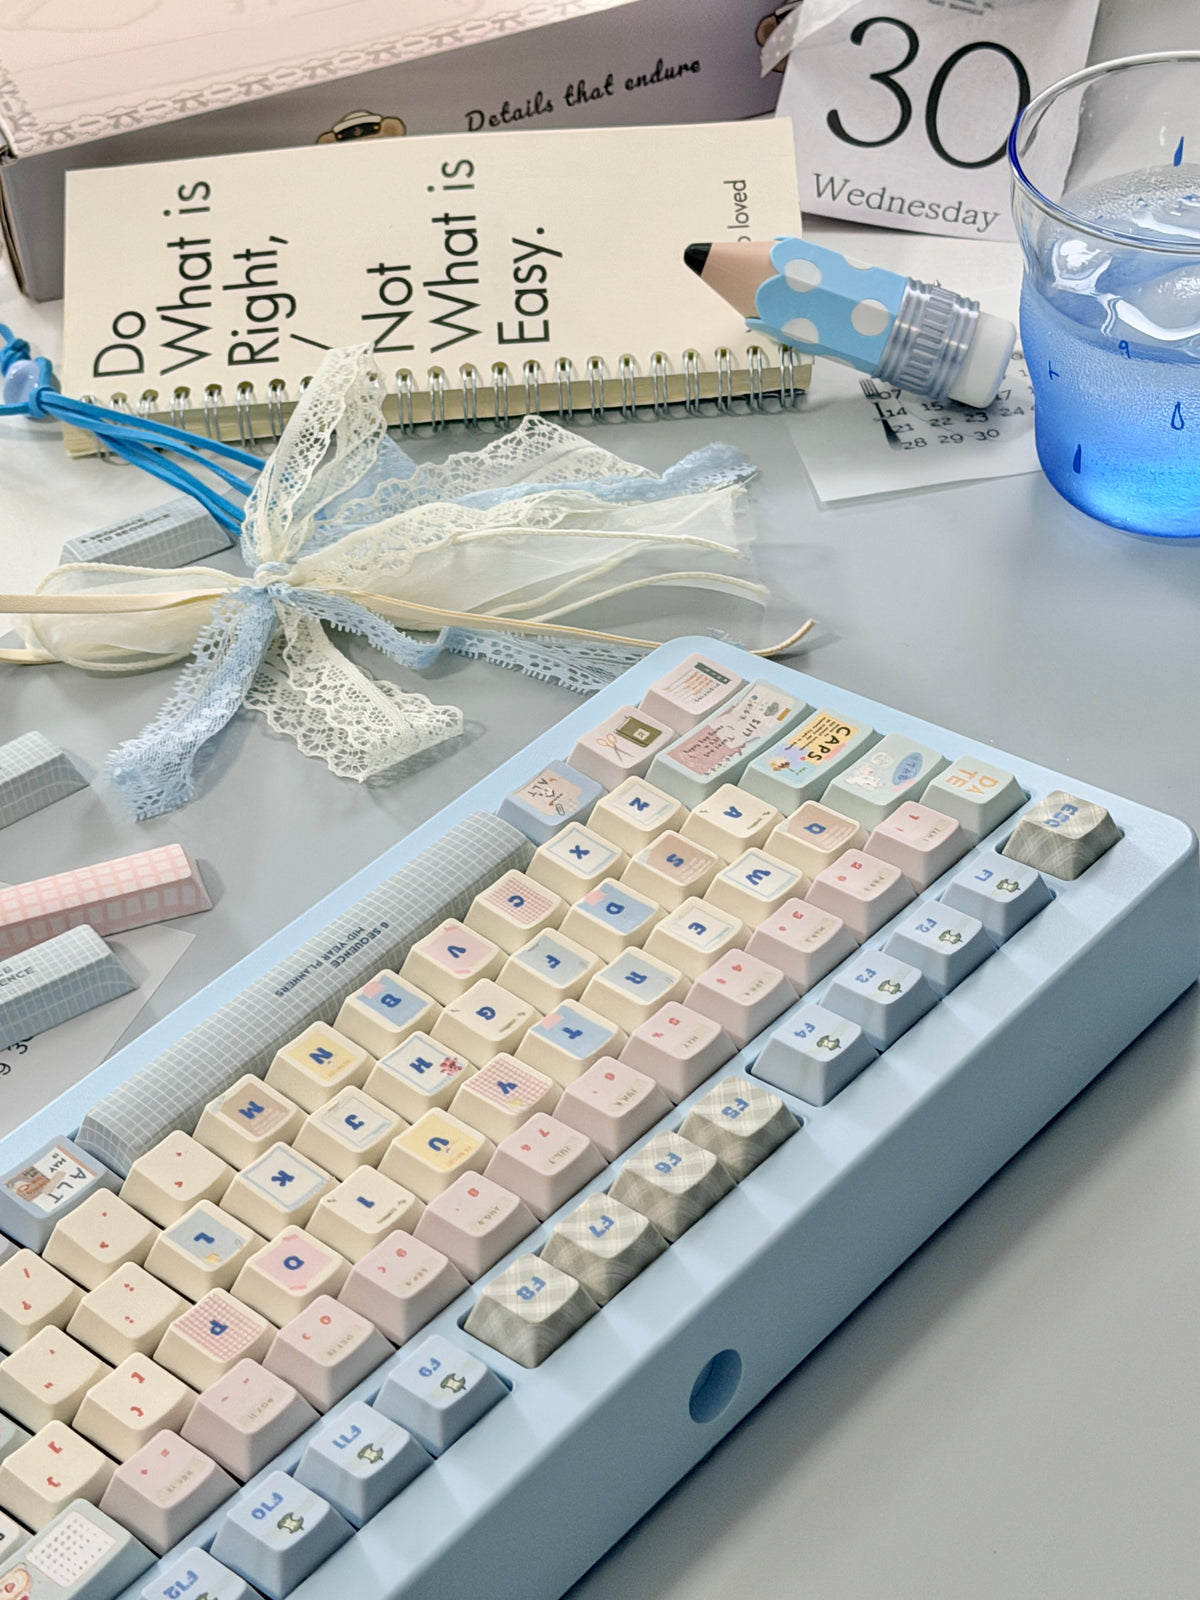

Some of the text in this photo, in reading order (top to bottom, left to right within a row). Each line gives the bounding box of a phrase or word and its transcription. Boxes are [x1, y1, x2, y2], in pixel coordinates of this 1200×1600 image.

[465, 58, 701, 132] Details that endure
[826, 16, 1031, 170] 30
[723, 179, 750, 229] loved
[813, 172, 1000, 234] Wednesday
[423, 159, 482, 353] What is
[156, 180, 213, 376] What is
[497, 226, 563, 346] Easy.
[222, 235, 298, 366] Right,
[361, 263, 415, 354] Not
[93, 309, 147, 378] Do
[885, 401, 944, 417] 14 15
[929, 417, 953, 426] 22
[965, 411, 989, 422] 23
[999, 406, 1025, 417] 24
[901, 428, 1000, 450] 28 29 30
[807, 726, 851, 761] CAPS
[723, 806, 742, 819] A
[1044, 804, 1078, 828] ESC
[804, 823, 826, 835] Q
[569, 845, 589, 860] X
[666, 853, 684, 868] S
[975, 869, 994, 883] F1
[508, 895, 525, 908] C
[605, 901, 625, 915] D
[688, 922, 707, 936] E
[916, 917, 937, 933] F2
[330, 927, 382, 969] SEQUENCE
[447, 945, 467, 959] V
[546, 954, 561, 970] F
[625, 971, 647, 985] R
[855, 967, 877, 983] F3
[380, 993, 402, 1008] B
[476, 1006, 496, 1021] G
[563, 1027, 583, 1040] T
[793, 1022, 816, 1039] F4
[309, 1047, 333, 1065] N
[410, 1057, 432, 1074] H
[497, 1081, 517, 1095] Y
[239, 1101, 264, 1120] M
[721, 1098, 749, 1119] F5
[427, 1136, 449, 1152] U
[655, 1152, 682, 1174] F6
[47, 1167, 87, 1204] ALT
[271, 1170, 295, 1187] K
[588, 1215, 614, 1238] F7
[283, 1255, 304, 1271] O
[516, 1276, 546, 1301] F8
[210, 1320, 228, 1336] P
[418, 1357, 441, 1378] F9
[332, 1425, 362, 1450] F11
[251, 1492, 284, 1520] F10
[163, 1570, 199, 1600] F12
